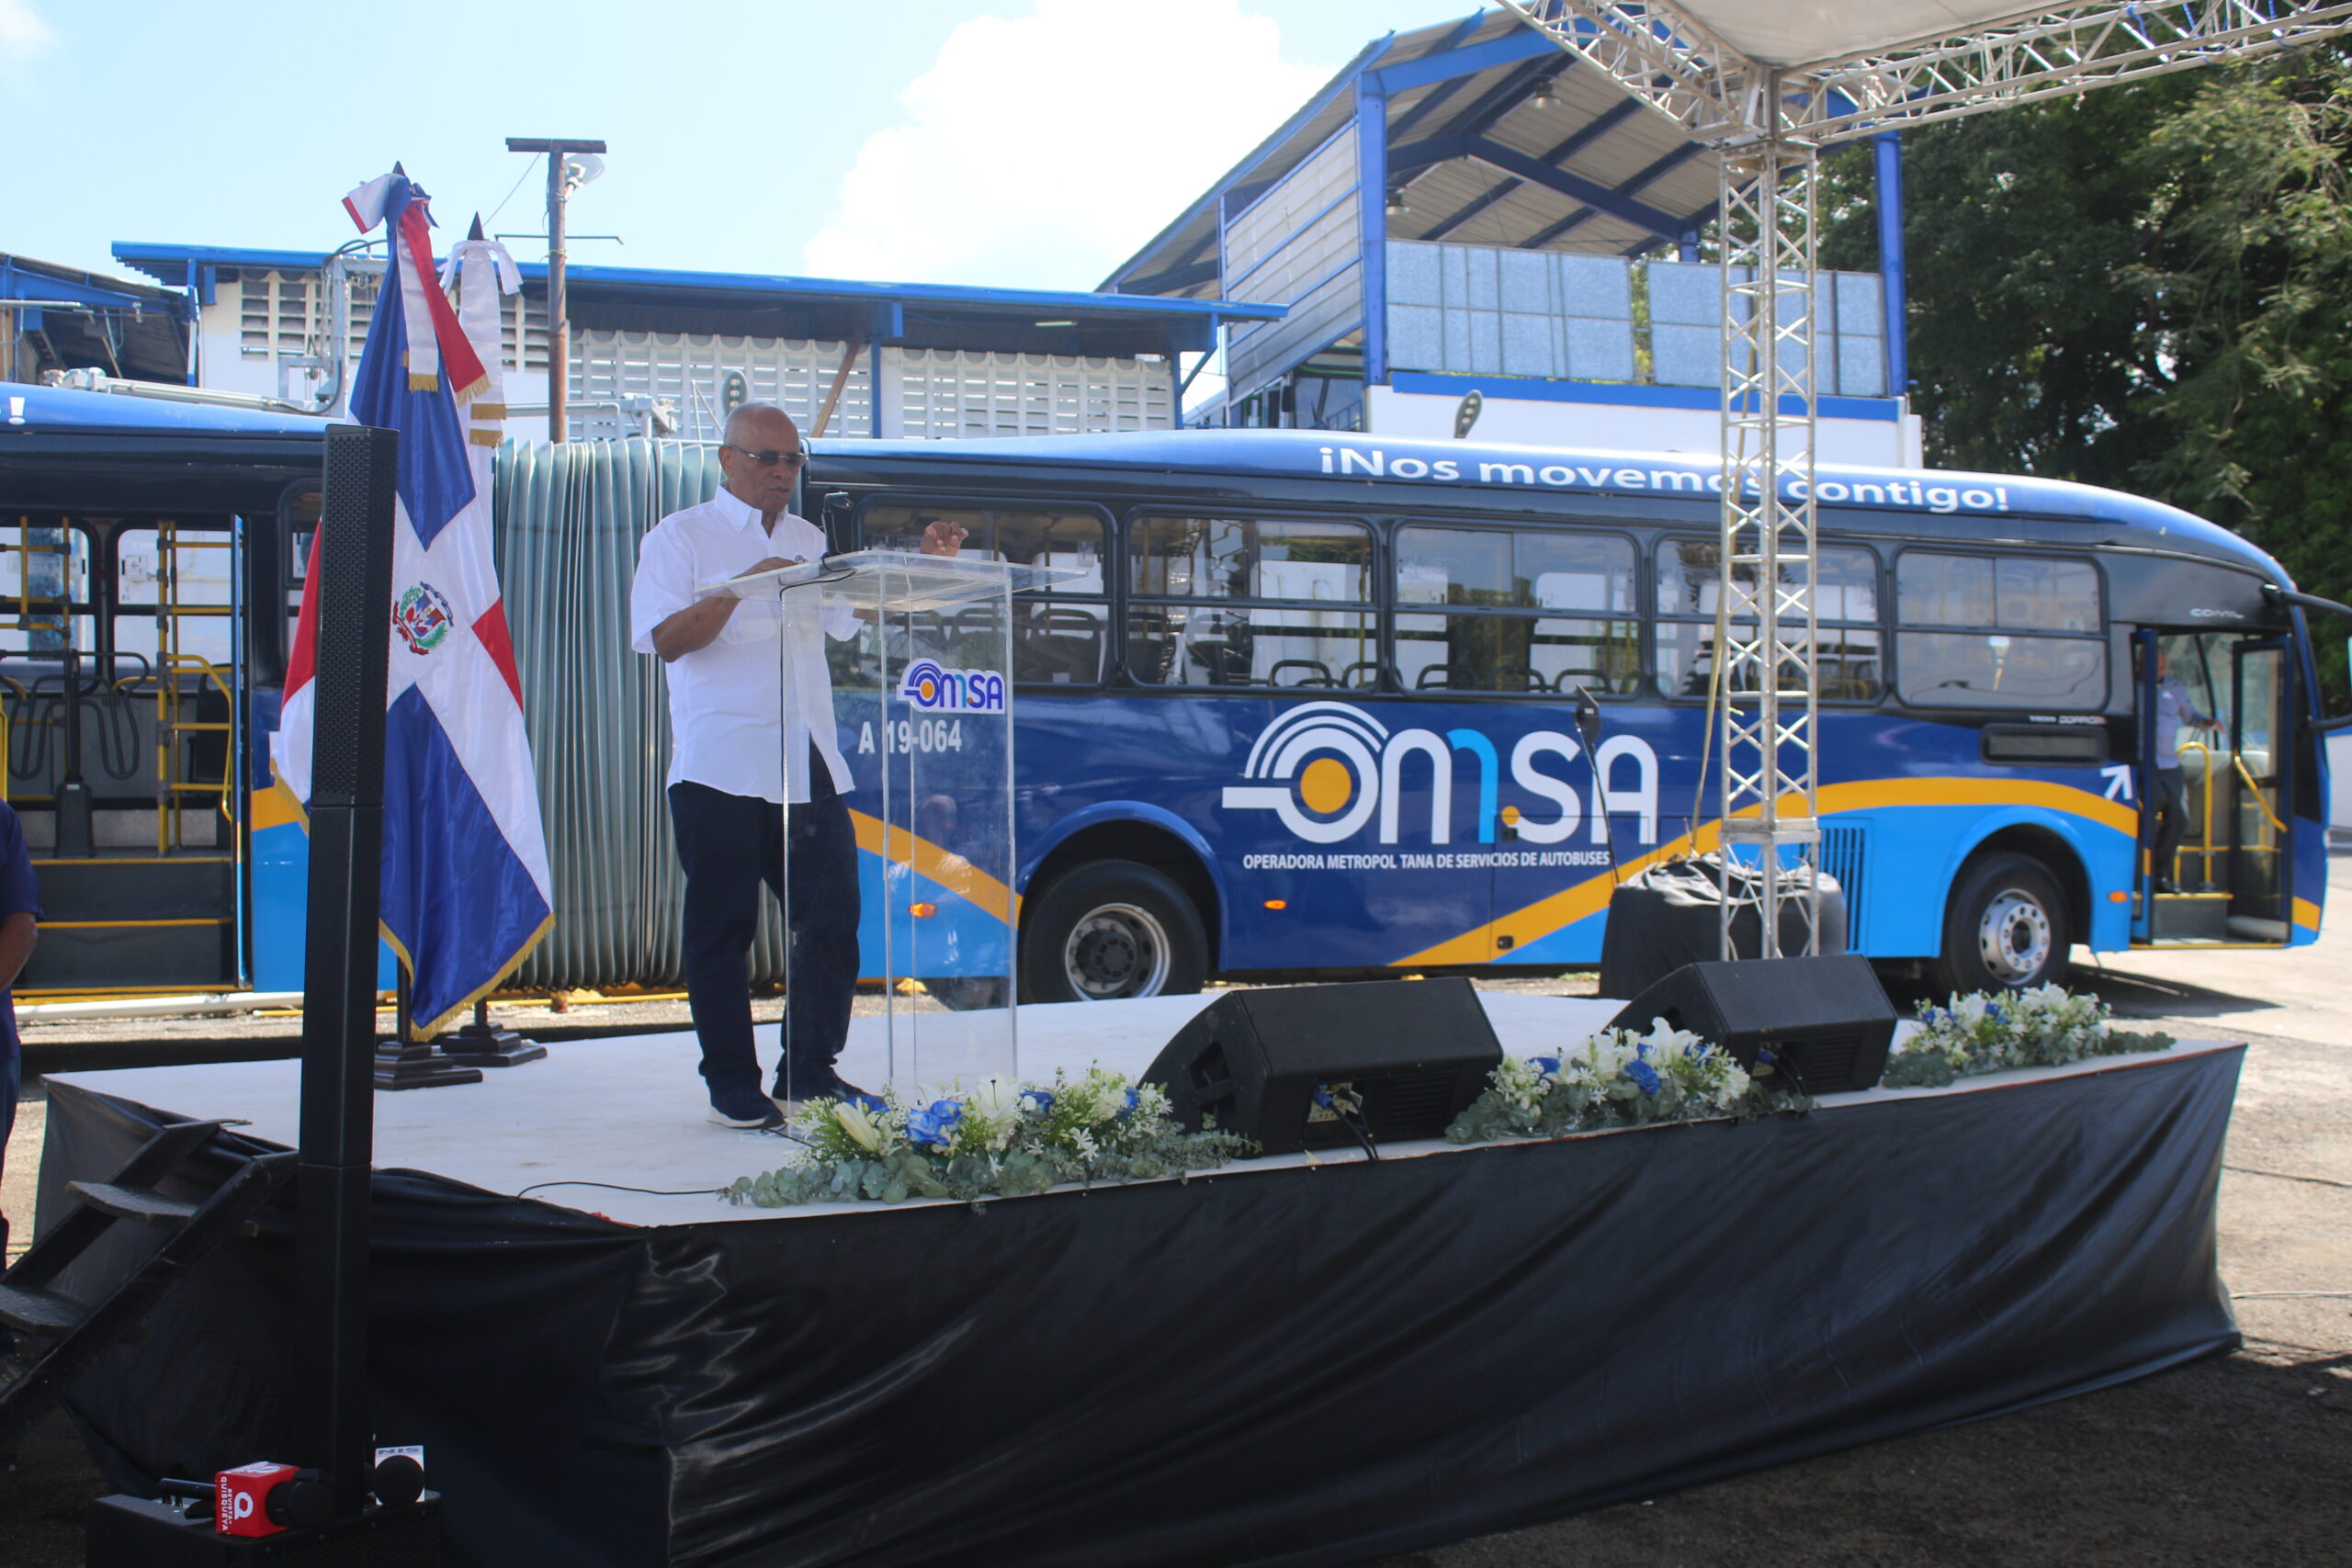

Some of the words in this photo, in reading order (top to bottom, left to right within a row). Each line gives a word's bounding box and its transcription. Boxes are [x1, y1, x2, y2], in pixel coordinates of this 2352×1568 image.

[1786, 479, 2010, 514] contigo!
[886, 719, 962, 753] 19-064
[1242, 854, 1325, 870] OPERADORA
[1436, 853, 1454, 868] DE
[1455, 852, 1518, 868] SERVICIOS
[1520, 852, 1538, 866] DE
[1539, 851, 1611, 866] AUTOBUSES
